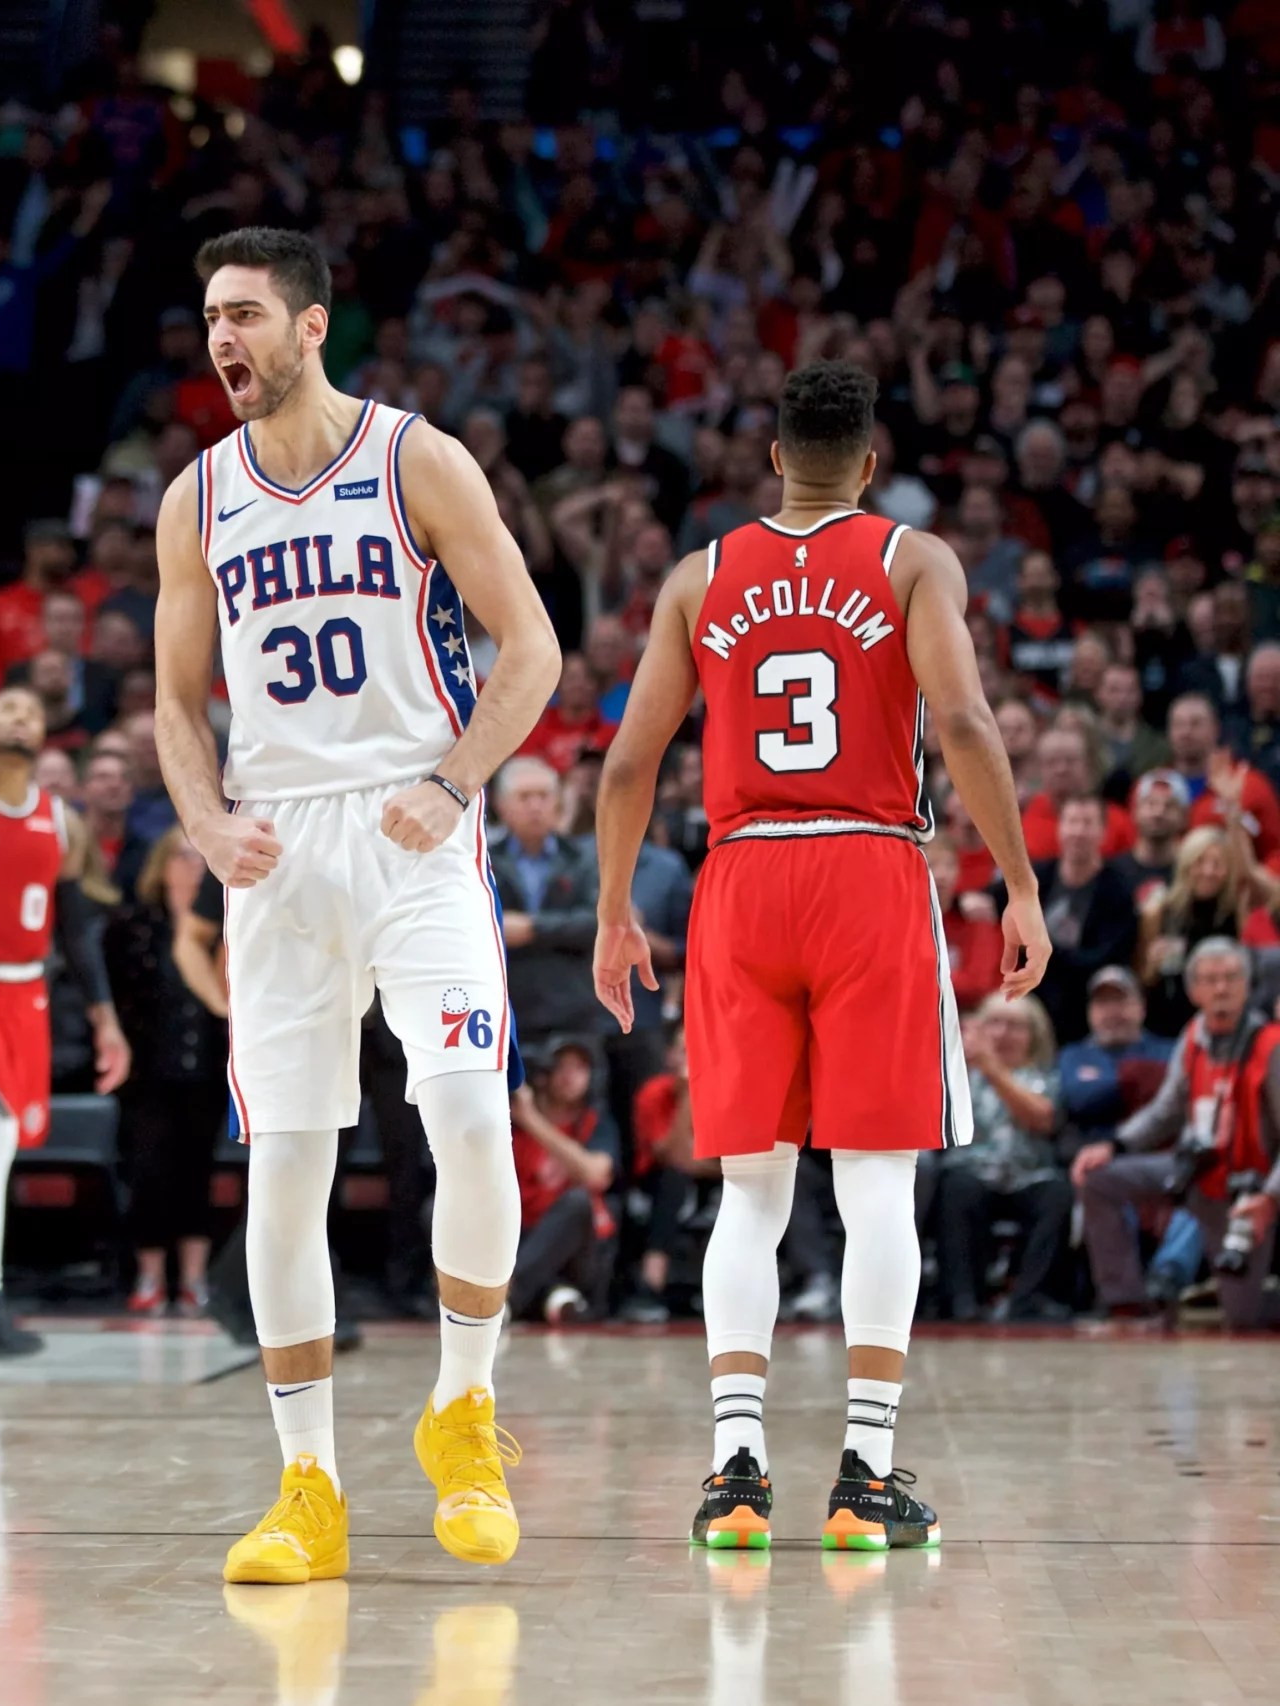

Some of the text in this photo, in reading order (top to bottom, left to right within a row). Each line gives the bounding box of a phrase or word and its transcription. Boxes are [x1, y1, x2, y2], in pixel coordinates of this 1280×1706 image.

[339, 485, 374, 497] StubHub
[216, 534, 401, 626] PHILA
[701, 577, 895, 660] McCOLLUM
[261, 617, 368, 705] 30
[754, 648, 841, 775] 3
[21, 883, 49, 932] 0
[441, 1007, 494, 1049] 76
